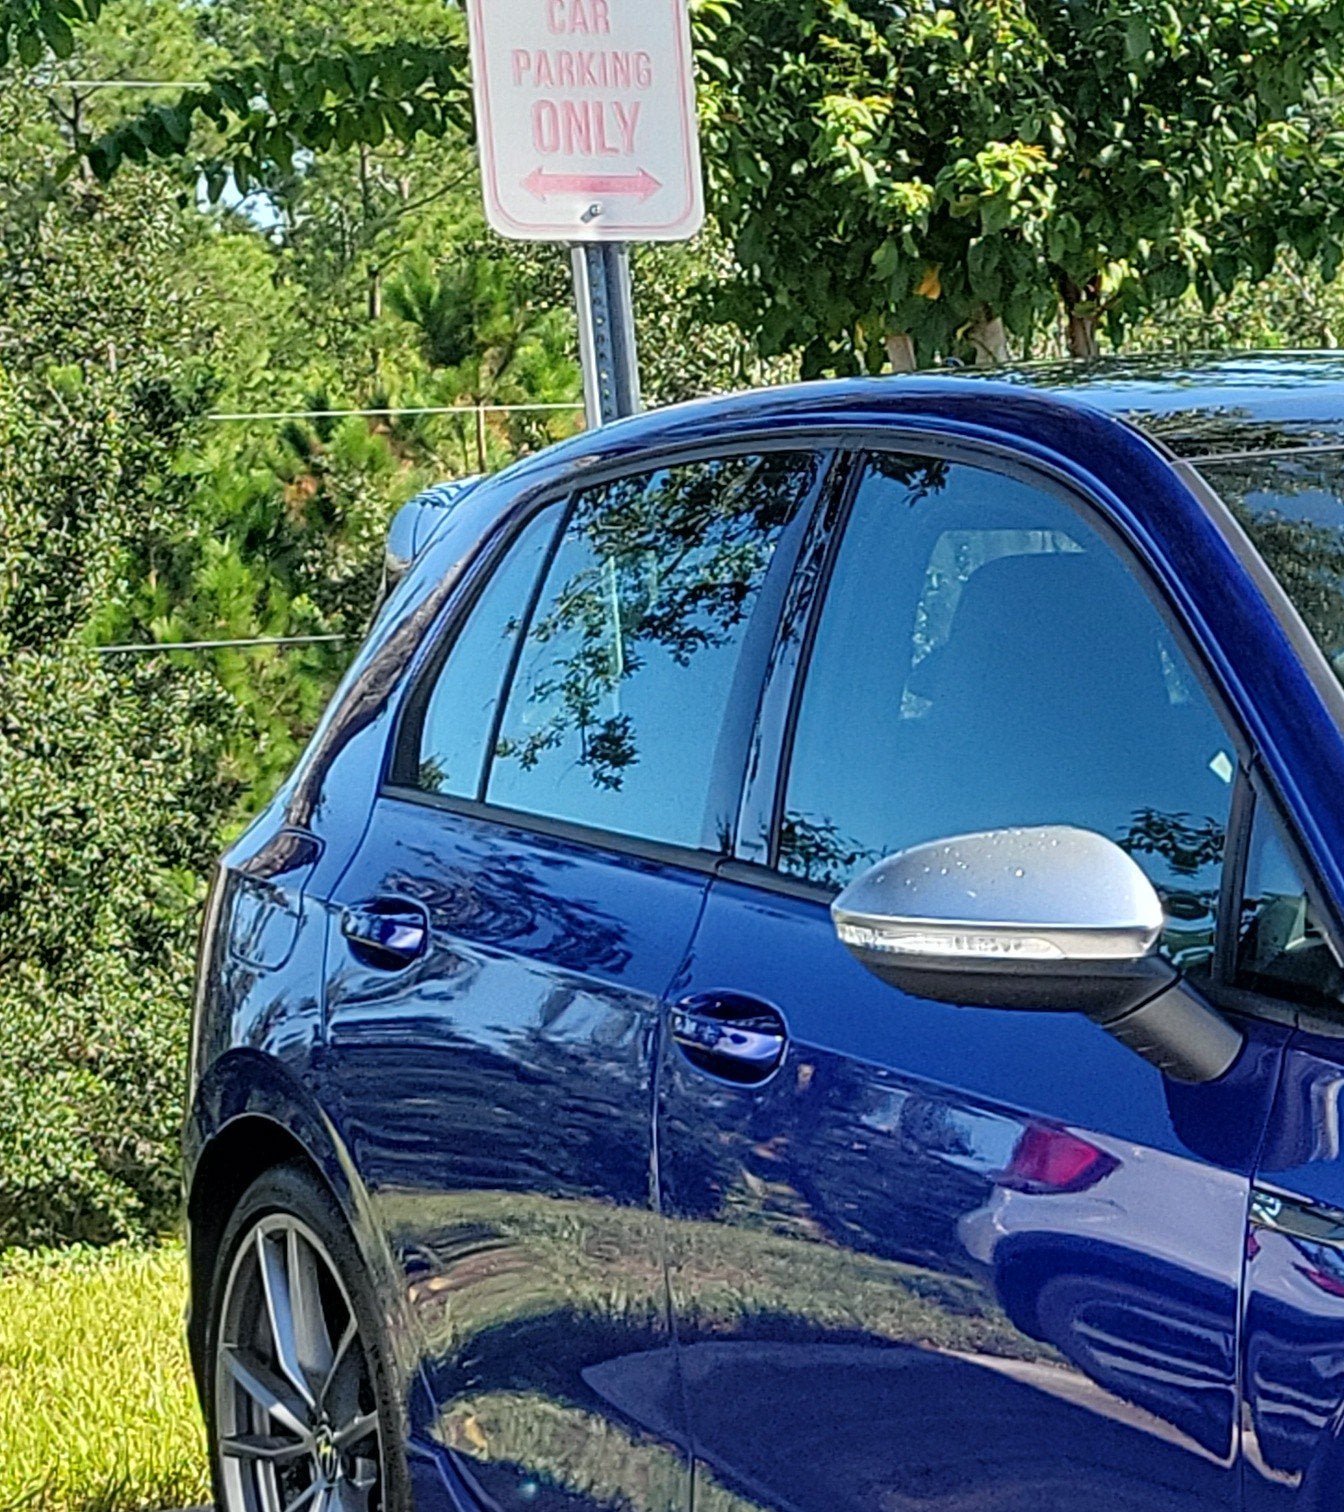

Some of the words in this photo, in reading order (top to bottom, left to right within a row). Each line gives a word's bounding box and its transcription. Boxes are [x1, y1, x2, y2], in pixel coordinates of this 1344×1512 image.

[546, 0, 610, 34] CAR
[511, 49, 651, 89] PARKING
[531, 99, 641, 156] ONLY
